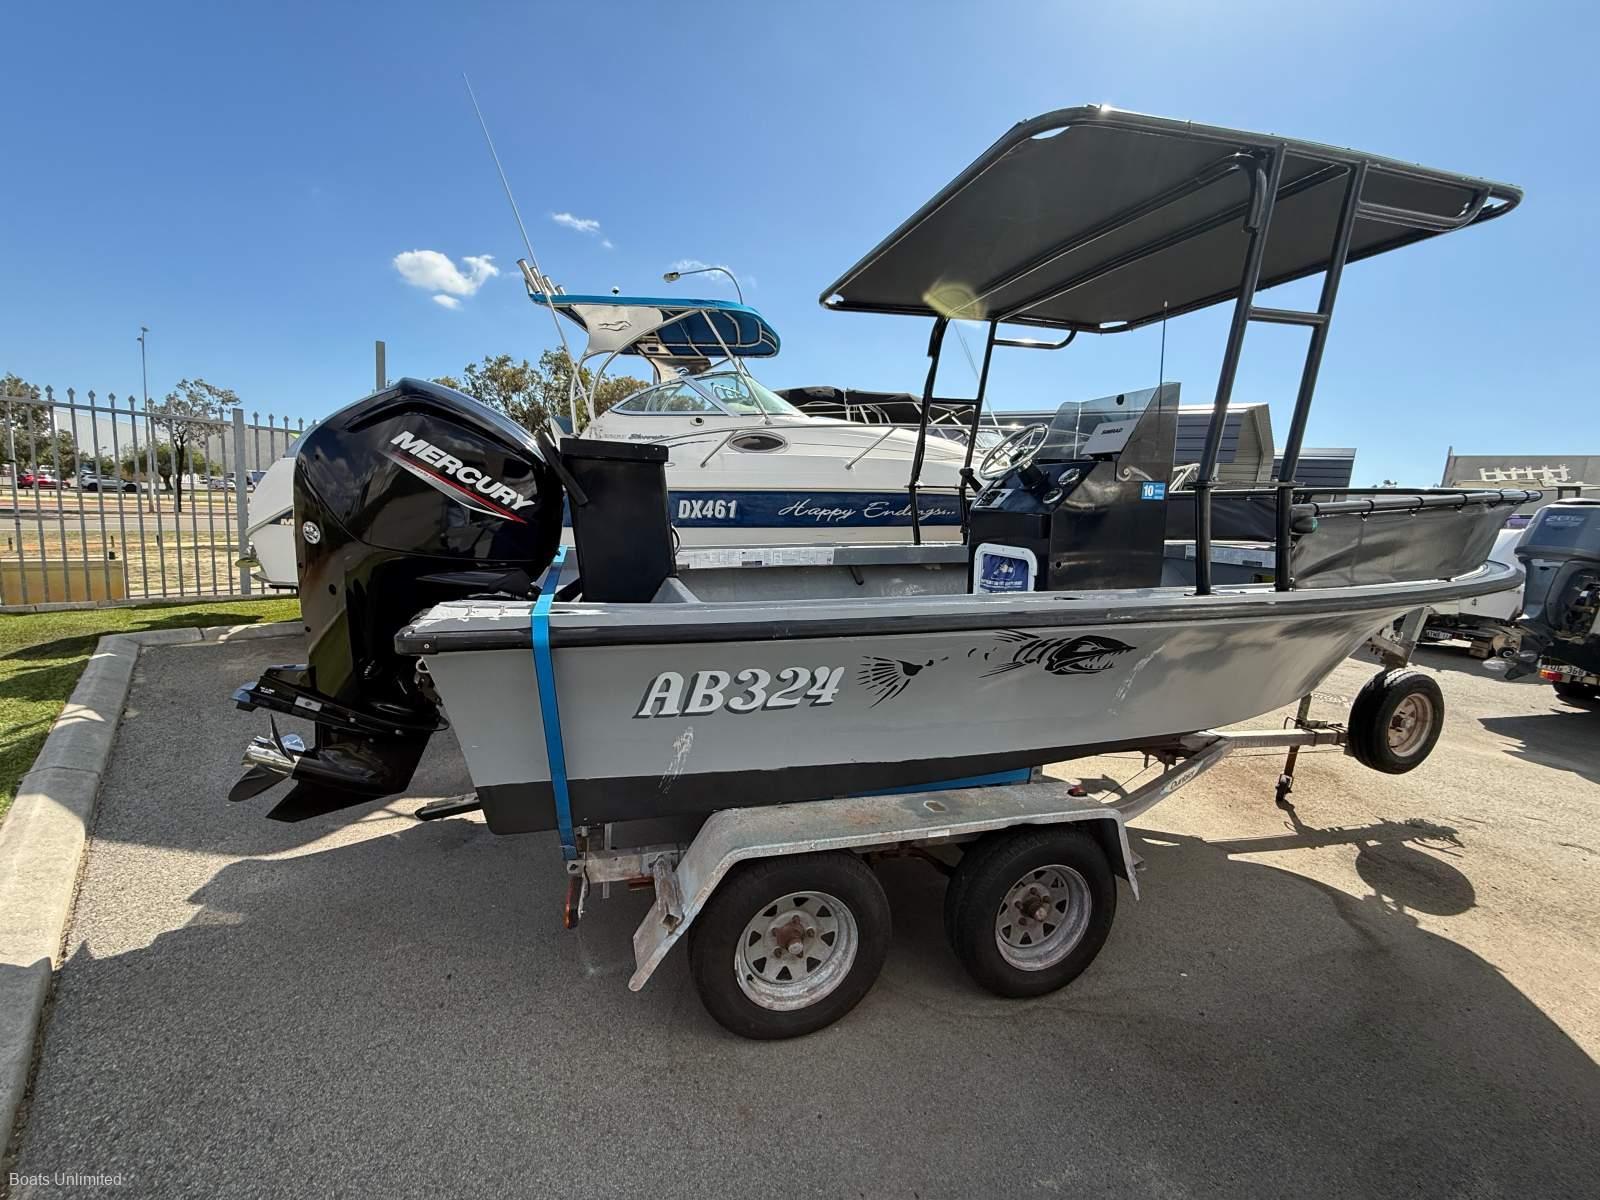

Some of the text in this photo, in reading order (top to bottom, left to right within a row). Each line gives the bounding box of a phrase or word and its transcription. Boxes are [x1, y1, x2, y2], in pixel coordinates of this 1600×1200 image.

[390, 430, 535, 511] MERCURY
[1143, 484, 1154, 497] 10
[678, 499, 737, 519] DX461
[778, 499, 856, 522] Happy
[632, 666, 845, 719] AB324
